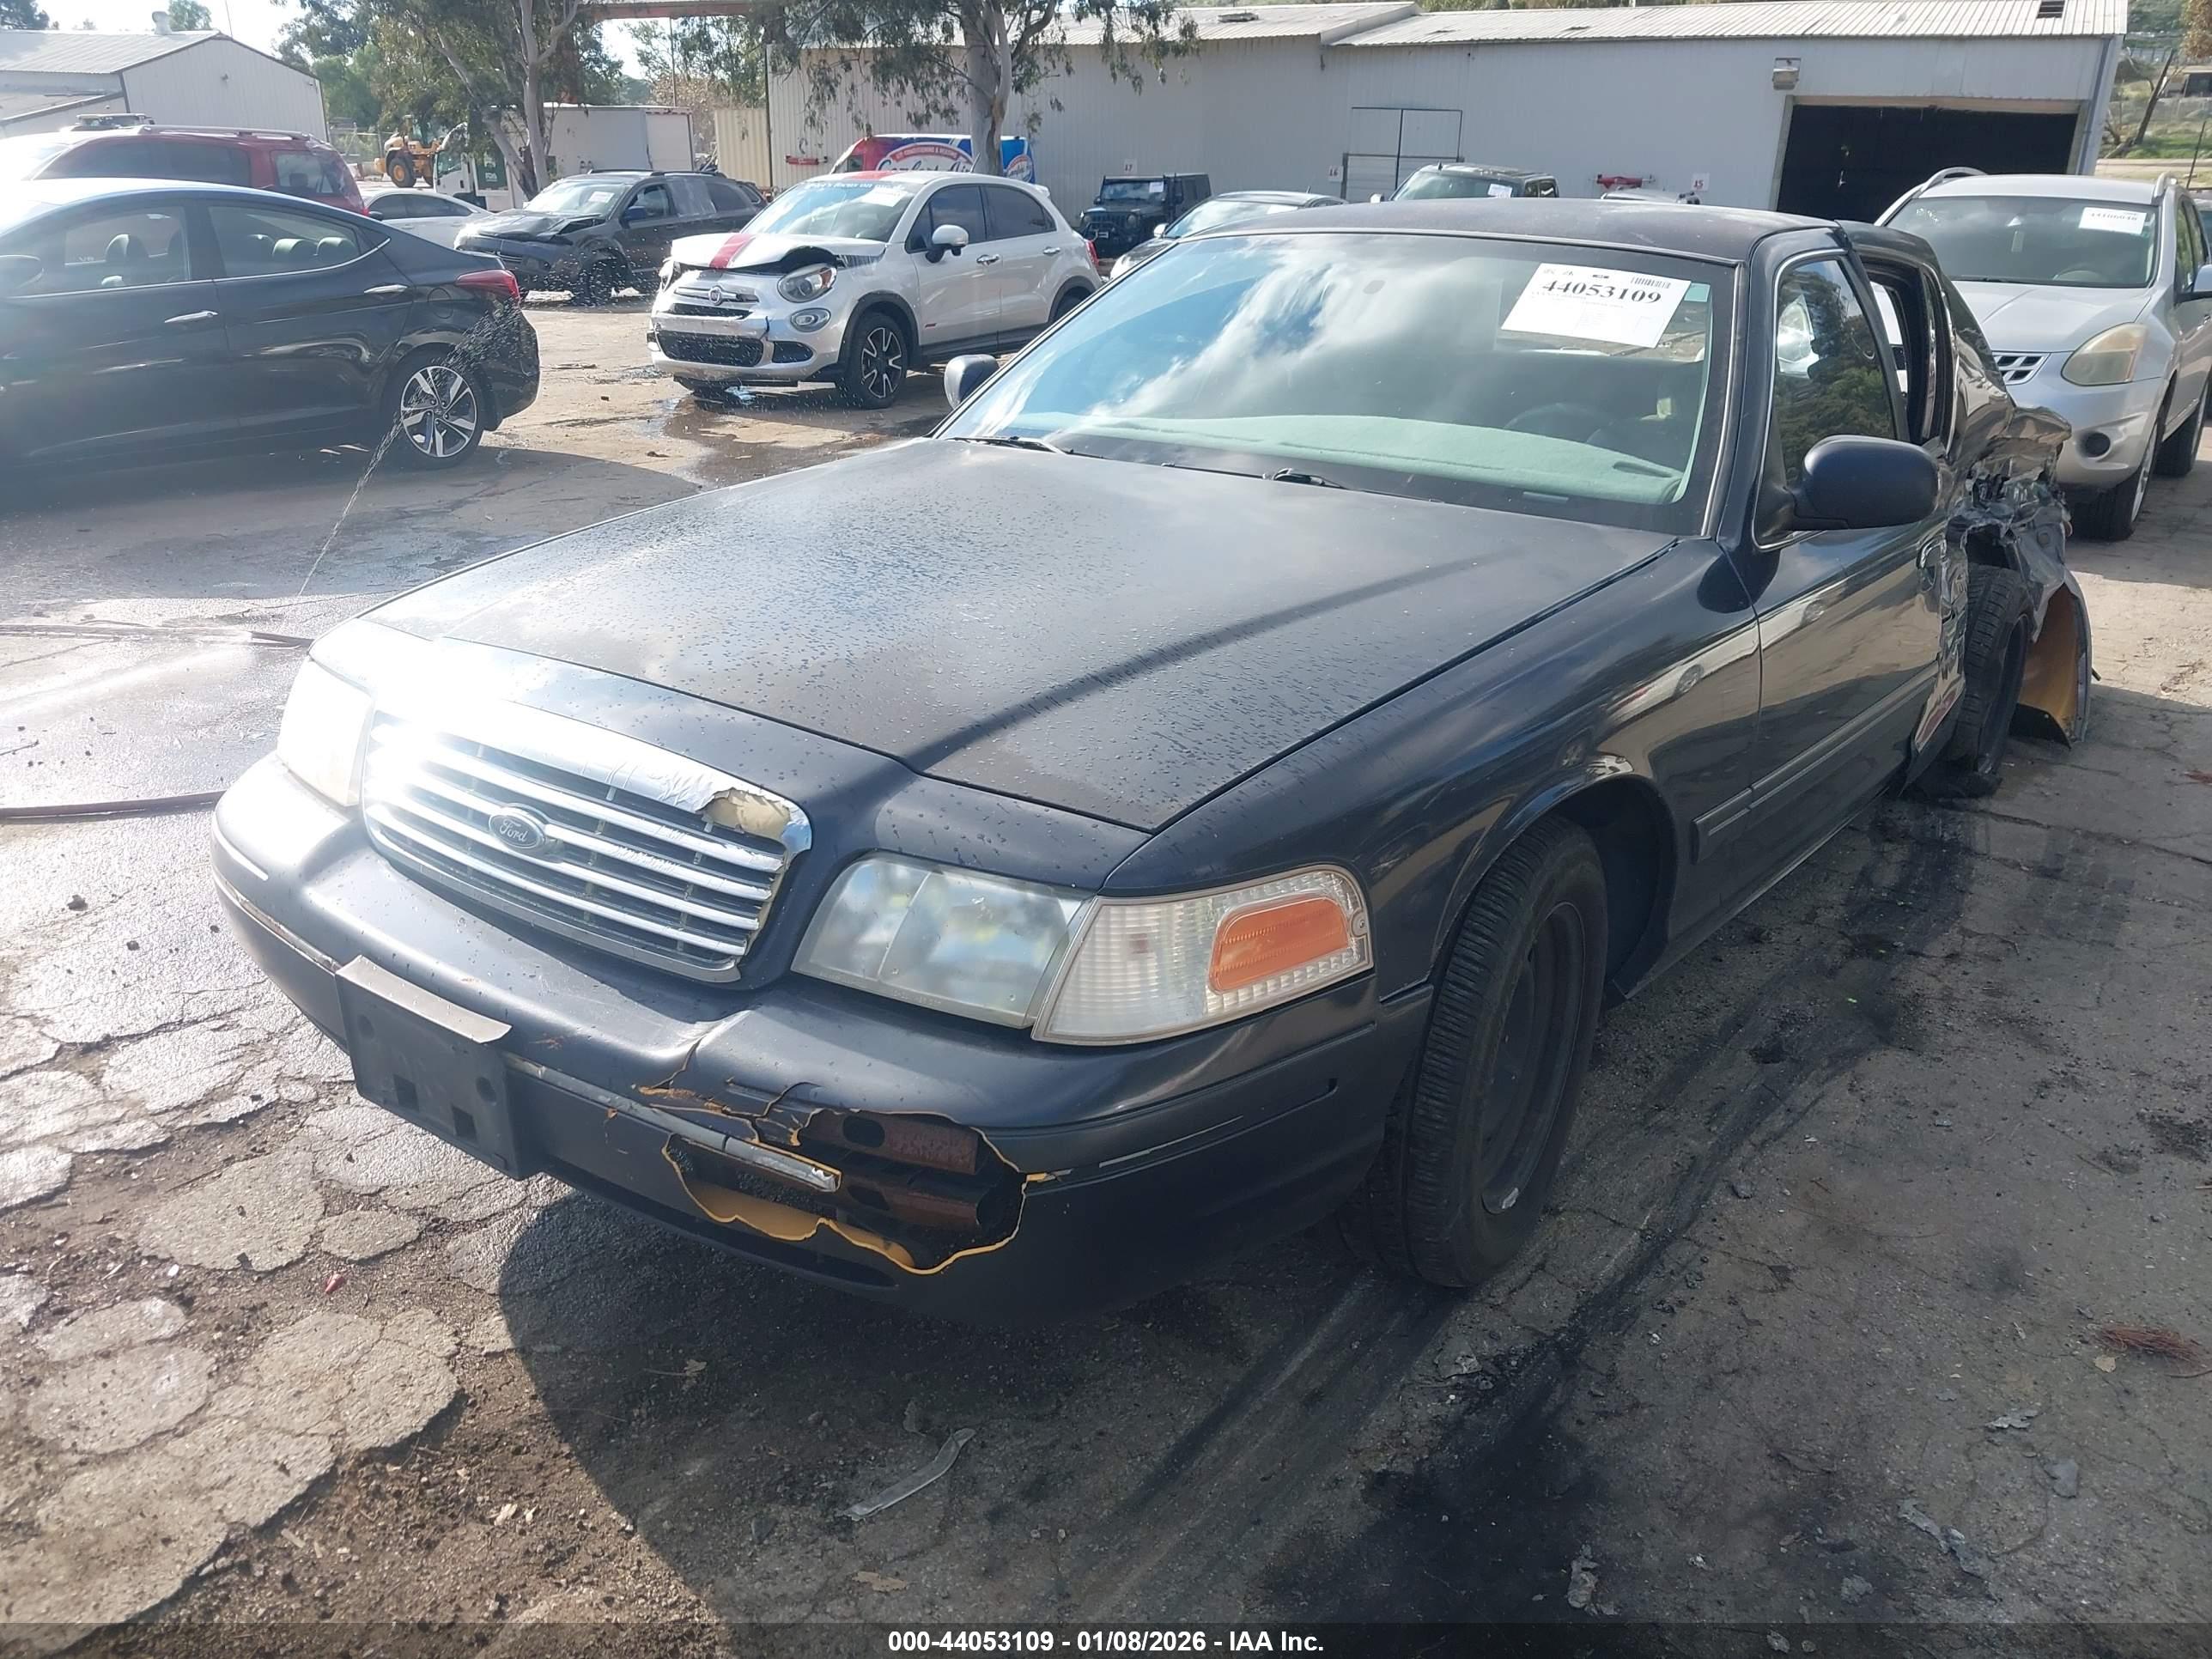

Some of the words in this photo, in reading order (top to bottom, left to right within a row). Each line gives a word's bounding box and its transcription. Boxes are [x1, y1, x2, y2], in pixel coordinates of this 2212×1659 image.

[1329, 167, 1340, 177] 16
[1693, 179, 1704, 188] 15
[1543, 280, 1662, 304] 44053109
[499, 818, 529, 842] Ford
